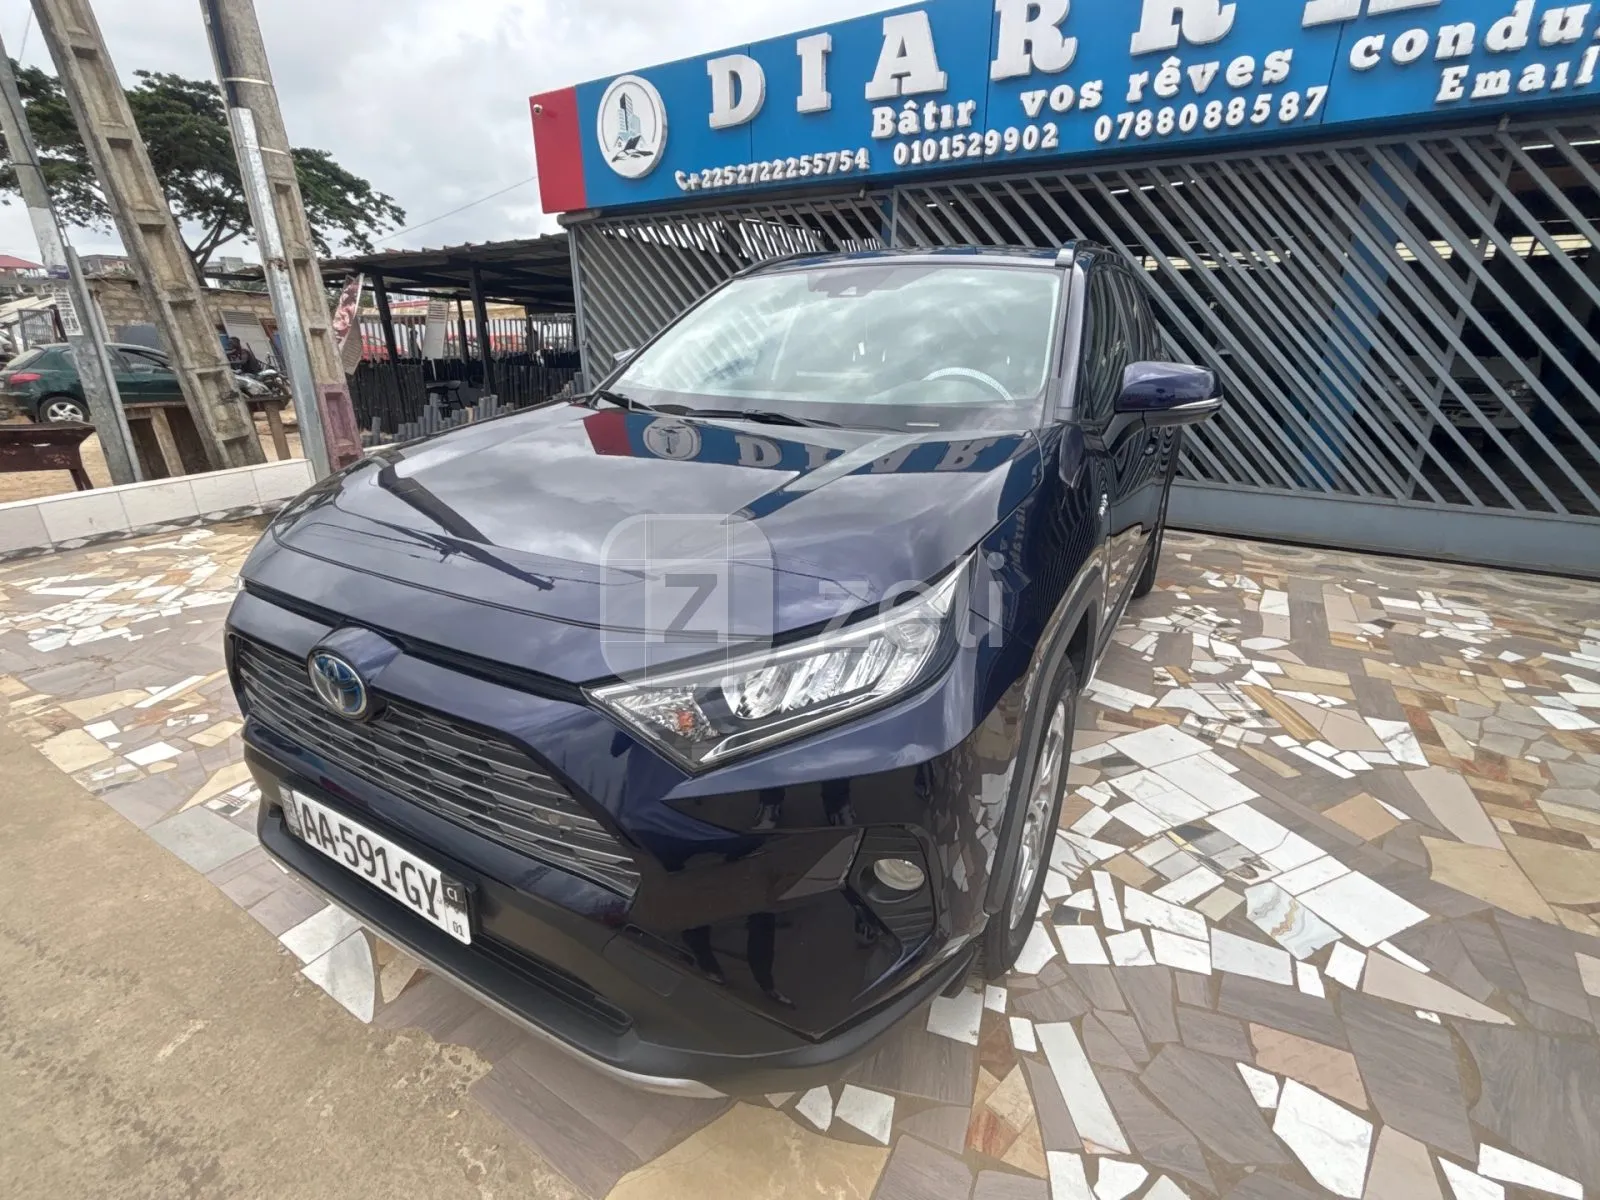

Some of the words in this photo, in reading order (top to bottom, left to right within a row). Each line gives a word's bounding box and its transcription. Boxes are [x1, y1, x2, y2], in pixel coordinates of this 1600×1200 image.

[707, 0, 1441, 130] DIARR
[1020, 79, 1103, 118] vos
[1126, 48, 1294, 103] rêves
[1350, 0, 1600, 71] condu
[893, 122, 1059, 166] 0101529902
[1094, 85, 1329, 143] 0788088587
